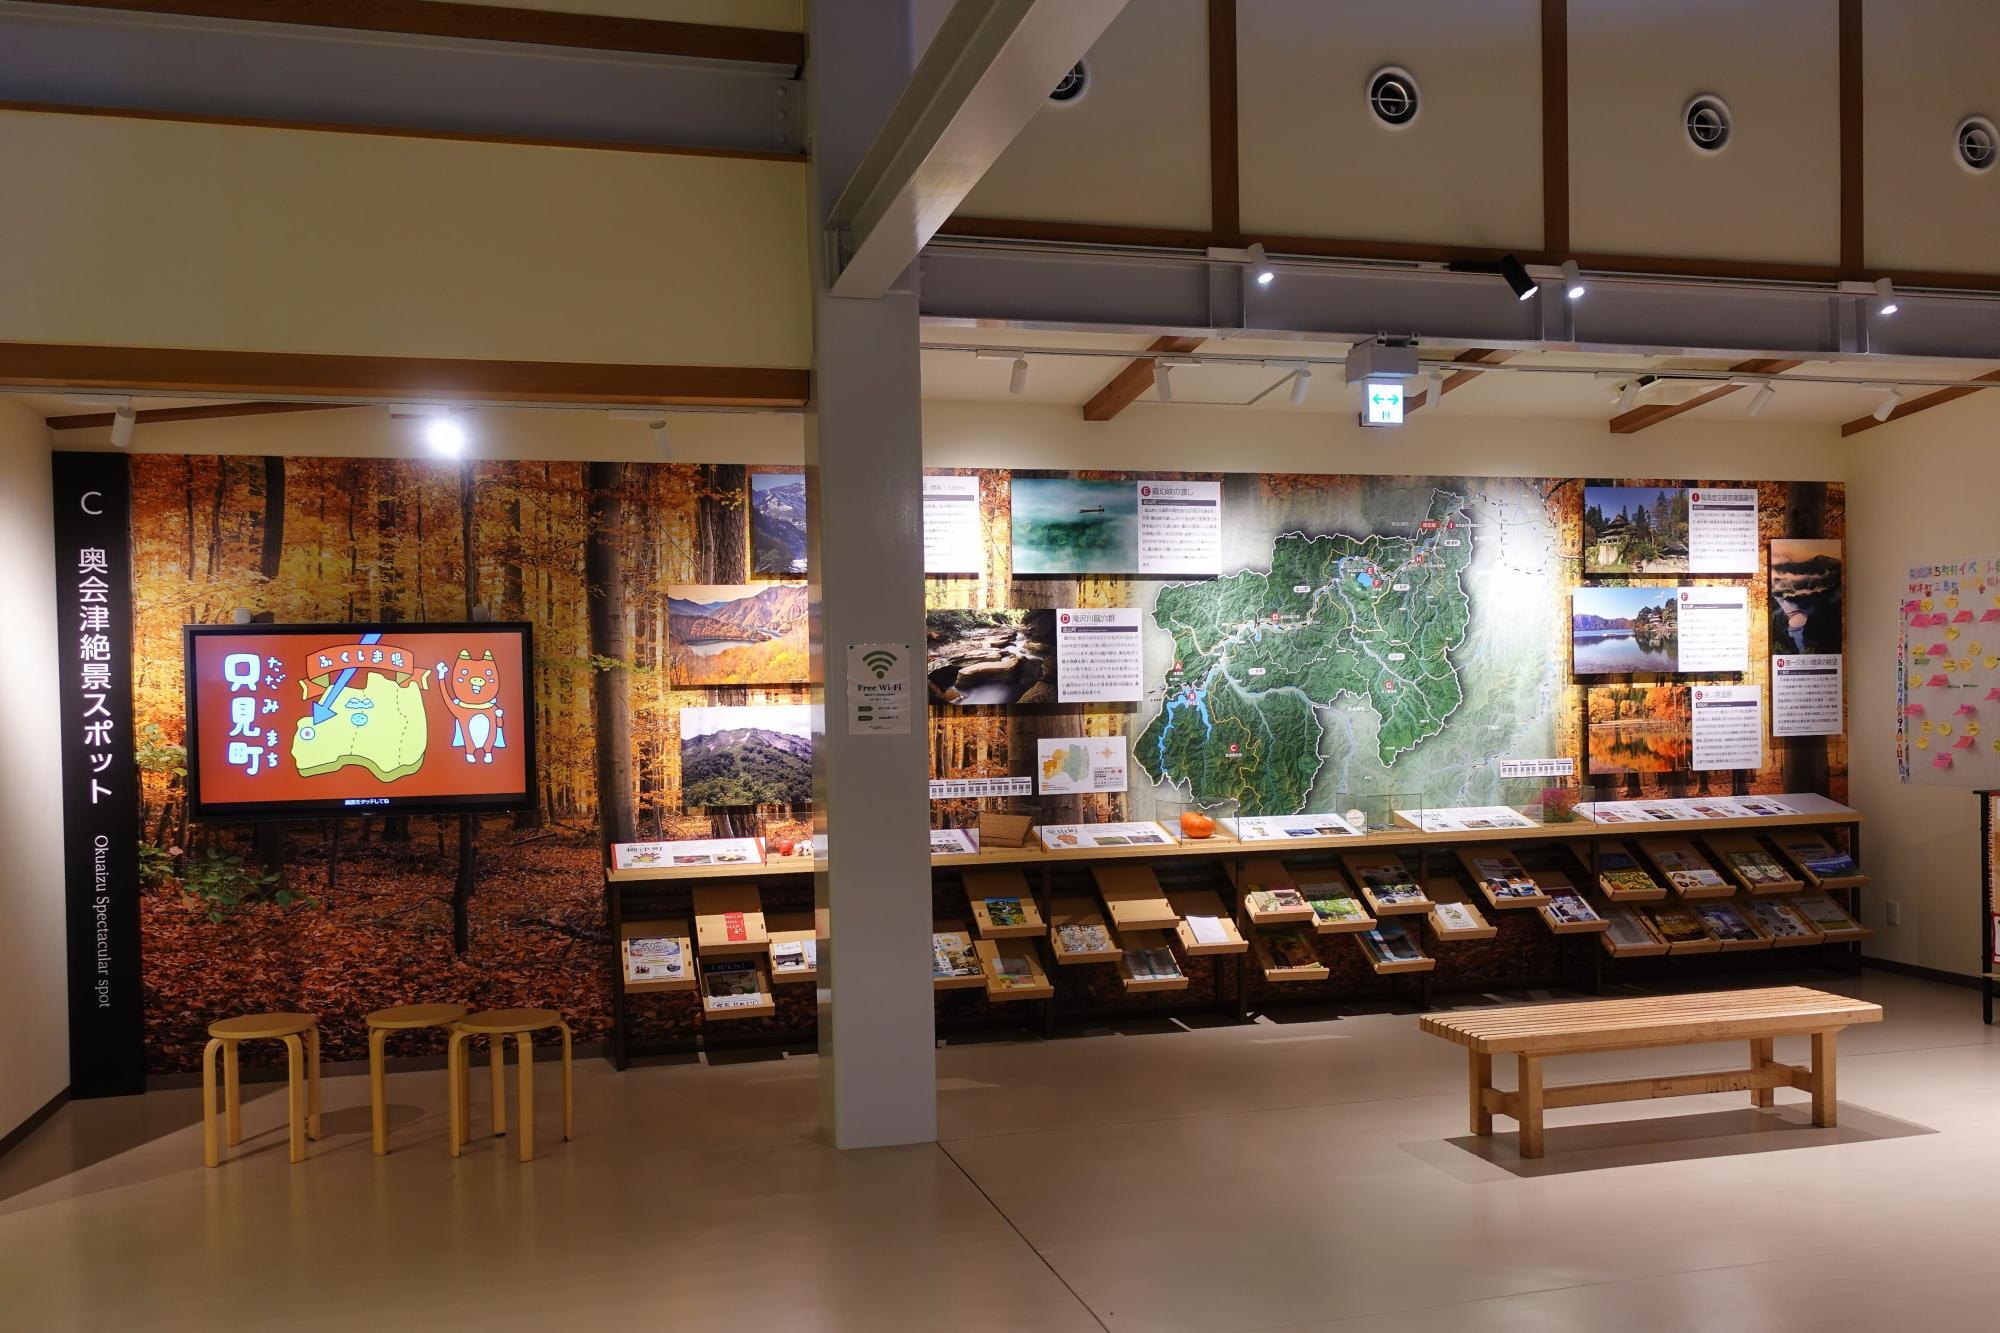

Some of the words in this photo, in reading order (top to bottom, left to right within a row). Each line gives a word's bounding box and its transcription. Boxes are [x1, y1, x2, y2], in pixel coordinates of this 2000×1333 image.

[80, 491, 102, 514] C
[318, 648, 404, 669] ふくしま県
[78, 547, 113, 804] 奥会津絶景スポット
[879, 683, 902, 691] Wi-Fi
[224, 652, 264, 776] 只見町
[344, 798, 390, 806] 画面をタッチしてね
[94, 835, 109, 892] Okuaizu
[93, 896, 111, 975] Spectacular
[95, 979, 110, 1008] spot
